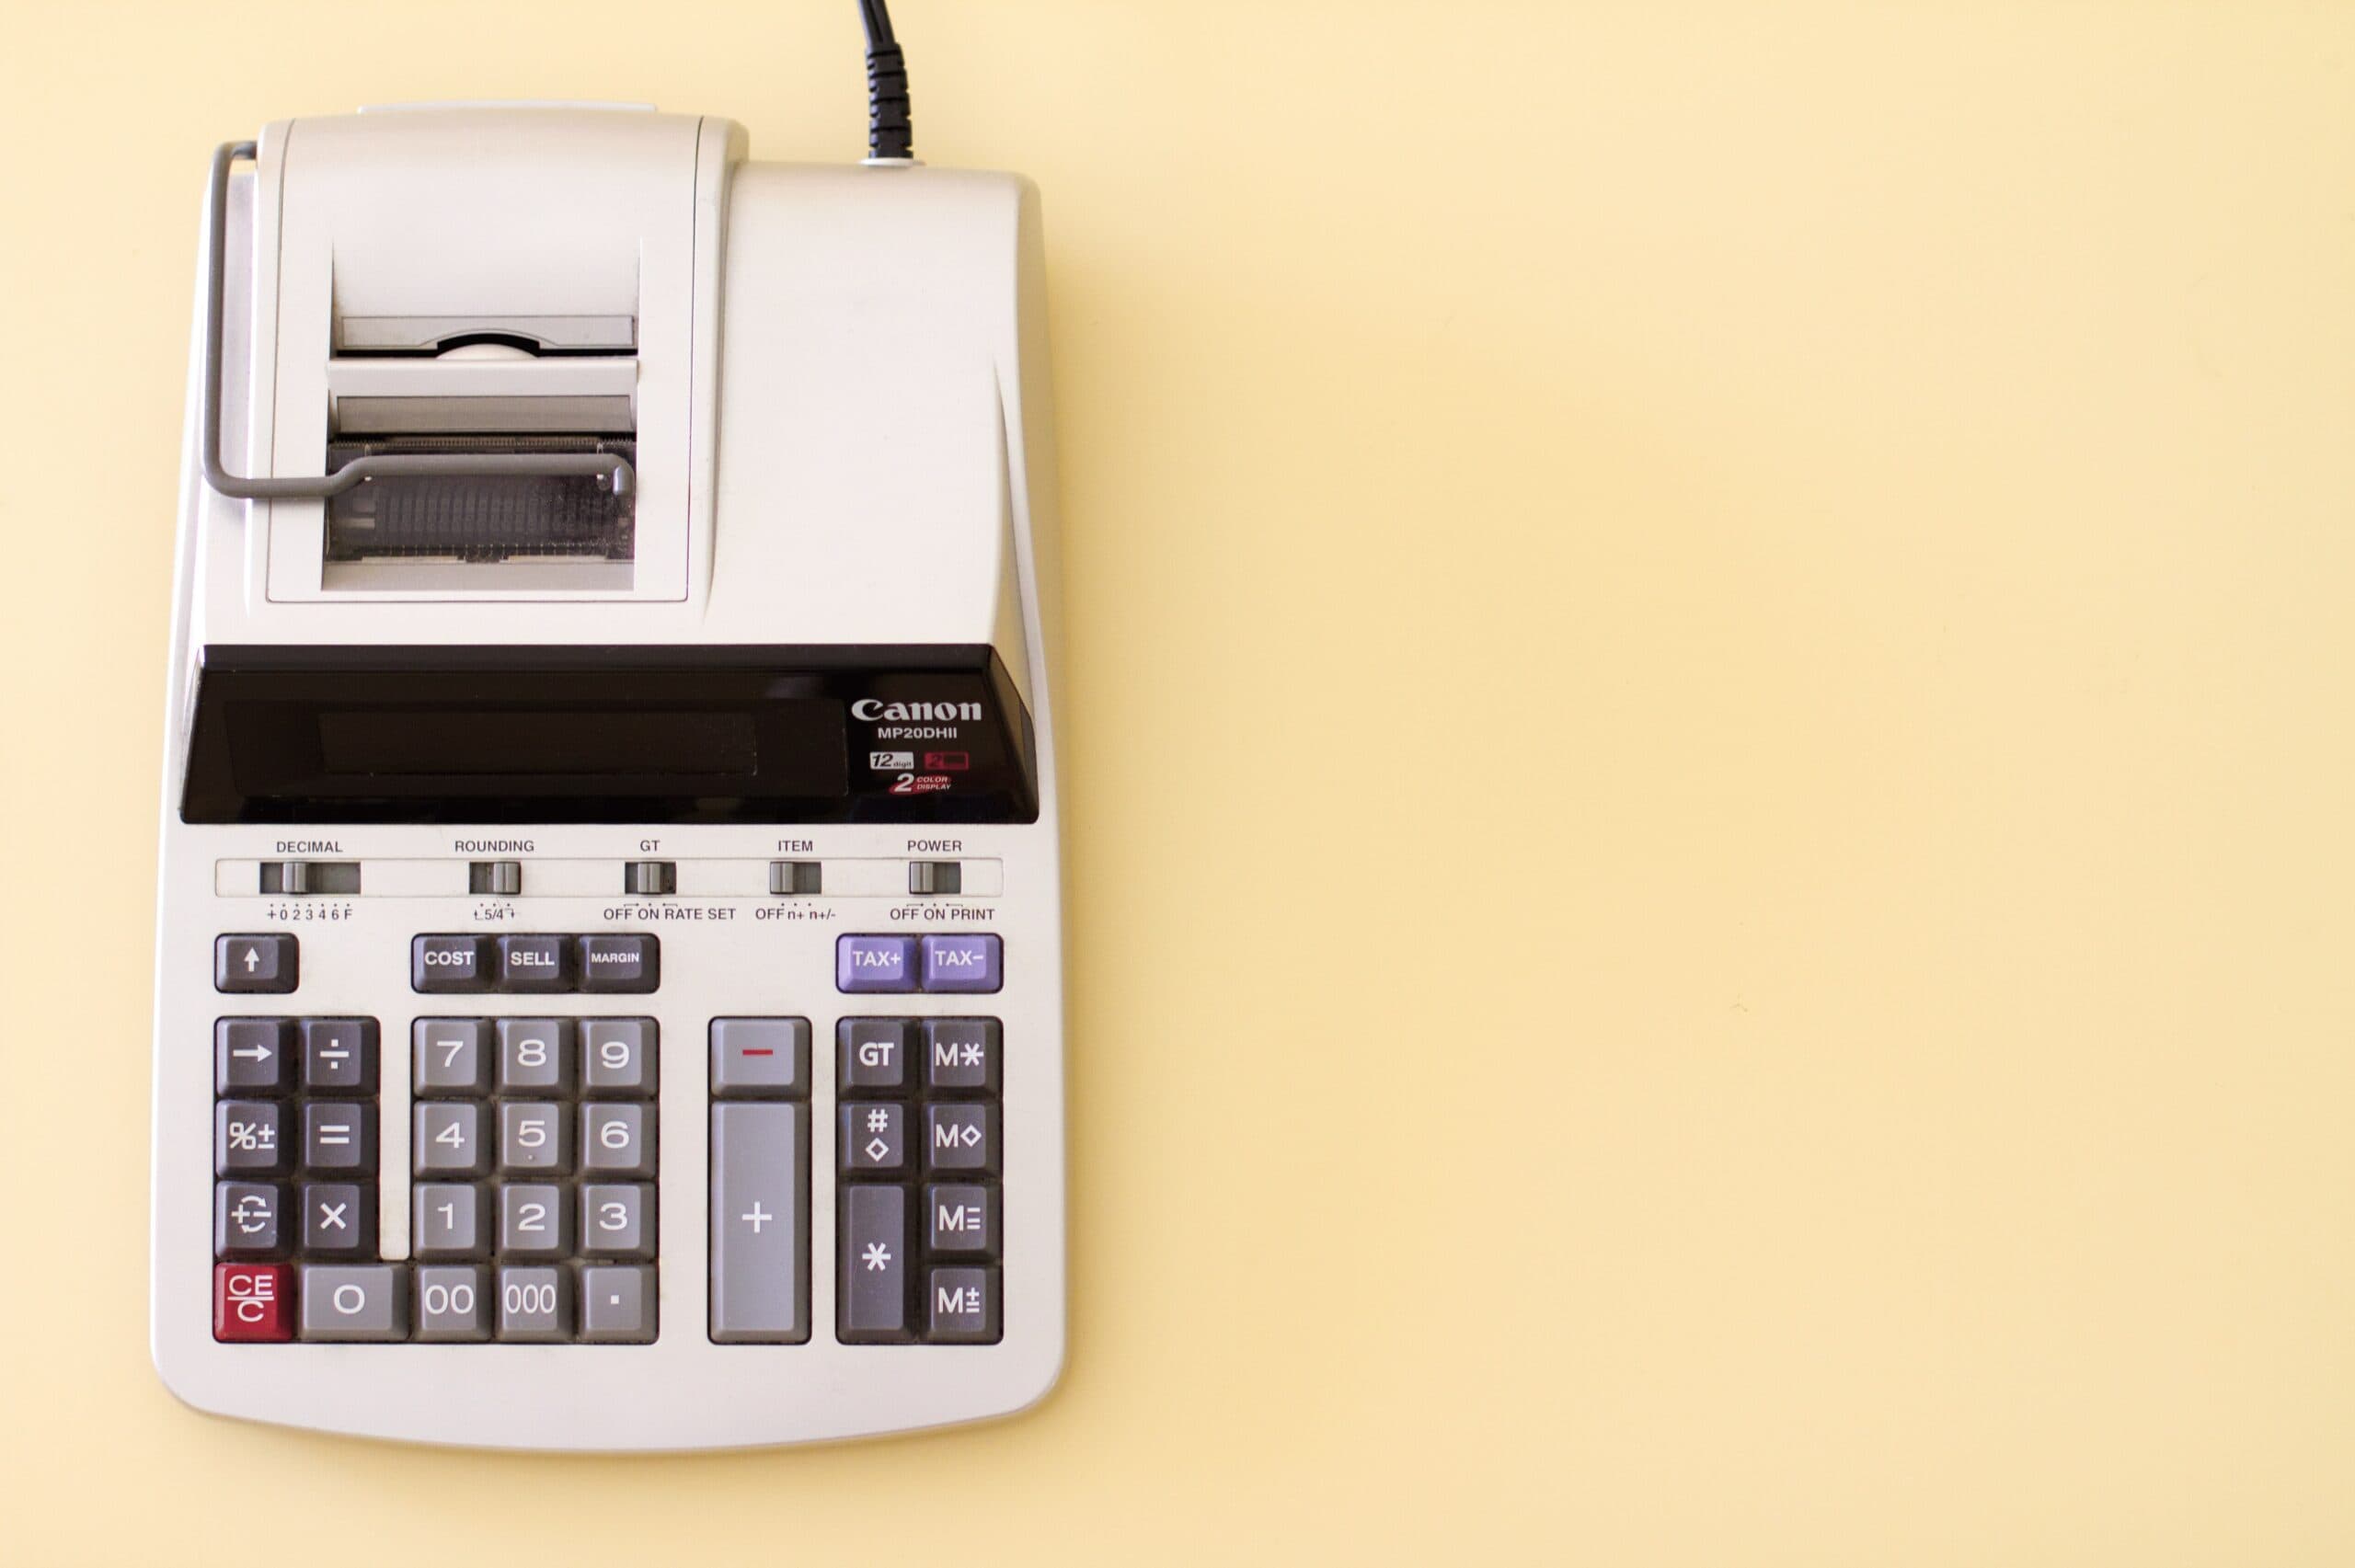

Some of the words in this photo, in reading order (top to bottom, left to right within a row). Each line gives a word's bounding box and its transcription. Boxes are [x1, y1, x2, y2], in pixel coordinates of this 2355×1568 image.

[852, 699, 981, 720] Canon
[879, 727, 957, 738] MP20DHII
[873, 754, 893, 767] 12
[894, 773, 914, 792] 2
[277, 841, 342, 853] DECIMAL
[455, 841, 534, 852] ROUNDING
[640, 841, 659, 852] GT
[779, 841, 812, 852] ITEM
[908, 841, 961, 851] POWER
[603, 909, 633, 920] OFF
[638, 909, 659, 920] ON
[665, 909, 702, 920] RATE
[708, 909, 736, 920] SET
[755, 909, 785, 920] OFF
[890, 909, 919, 920] OFF
[925, 909, 945, 920] ON
[951, 909, 994, 920] PRINT
[425, 951, 474, 965] COST
[511, 952, 555, 966] SELL
[592, 953, 639, 962] MARGIN
[853, 951, 901, 966] TAX+
[437, 1041, 464, 1067] 7
[518, 1039, 546, 1066] 8
[602, 1042, 629, 1069] 9
[859, 1043, 894, 1066] GT
[436, 1122, 465, 1148] 4
[519, 1120, 546, 1147] 5
[602, 1121, 629, 1148] 6
[438, 1203, 453, 1229] 1
[519, 1204, 546, 1230] 2
[600, 1203, 627, 1230] 3
[229, 1276, 273, 1295] CE
[334, 1285, 364, 1313] 0
[423, 1284, 474, 1316] 00
[503, 1282, 556, 1316] 000
[237, 1301, 263, 1322] C
